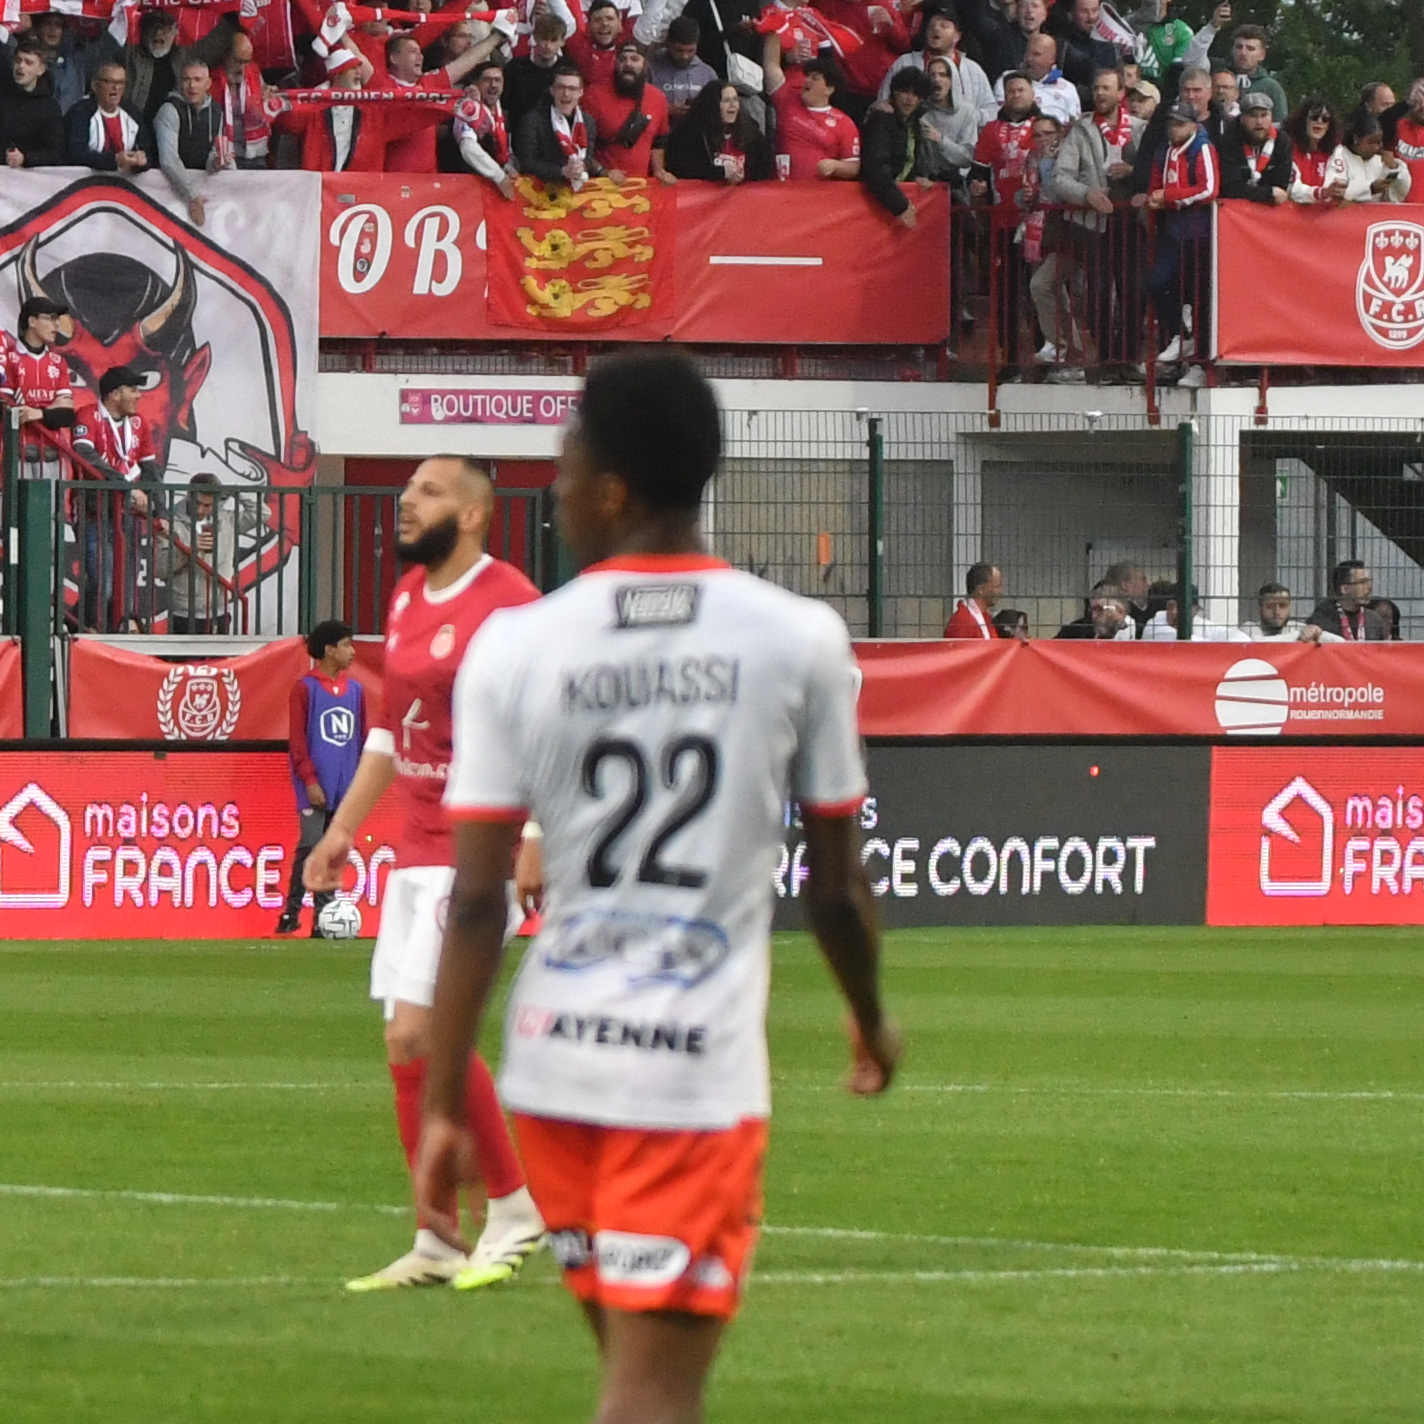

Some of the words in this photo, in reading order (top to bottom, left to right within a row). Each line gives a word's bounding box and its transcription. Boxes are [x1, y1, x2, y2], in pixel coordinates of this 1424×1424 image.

[431, 394, 539, 419] BOUTIQUE
[561, 659, 740, 713] KOUASSI
[1289, 681, 1385, 709] métropole
[84, 793, 241, 840] maisons
[582, 733, 724, 890] 22
[1345, 787, 1424, 832] mais
[82, 845, 284, 910] FRANCE
[928, 836, 1157, 897] CONFORT
[1345, 838, 1424, 896] FRA
